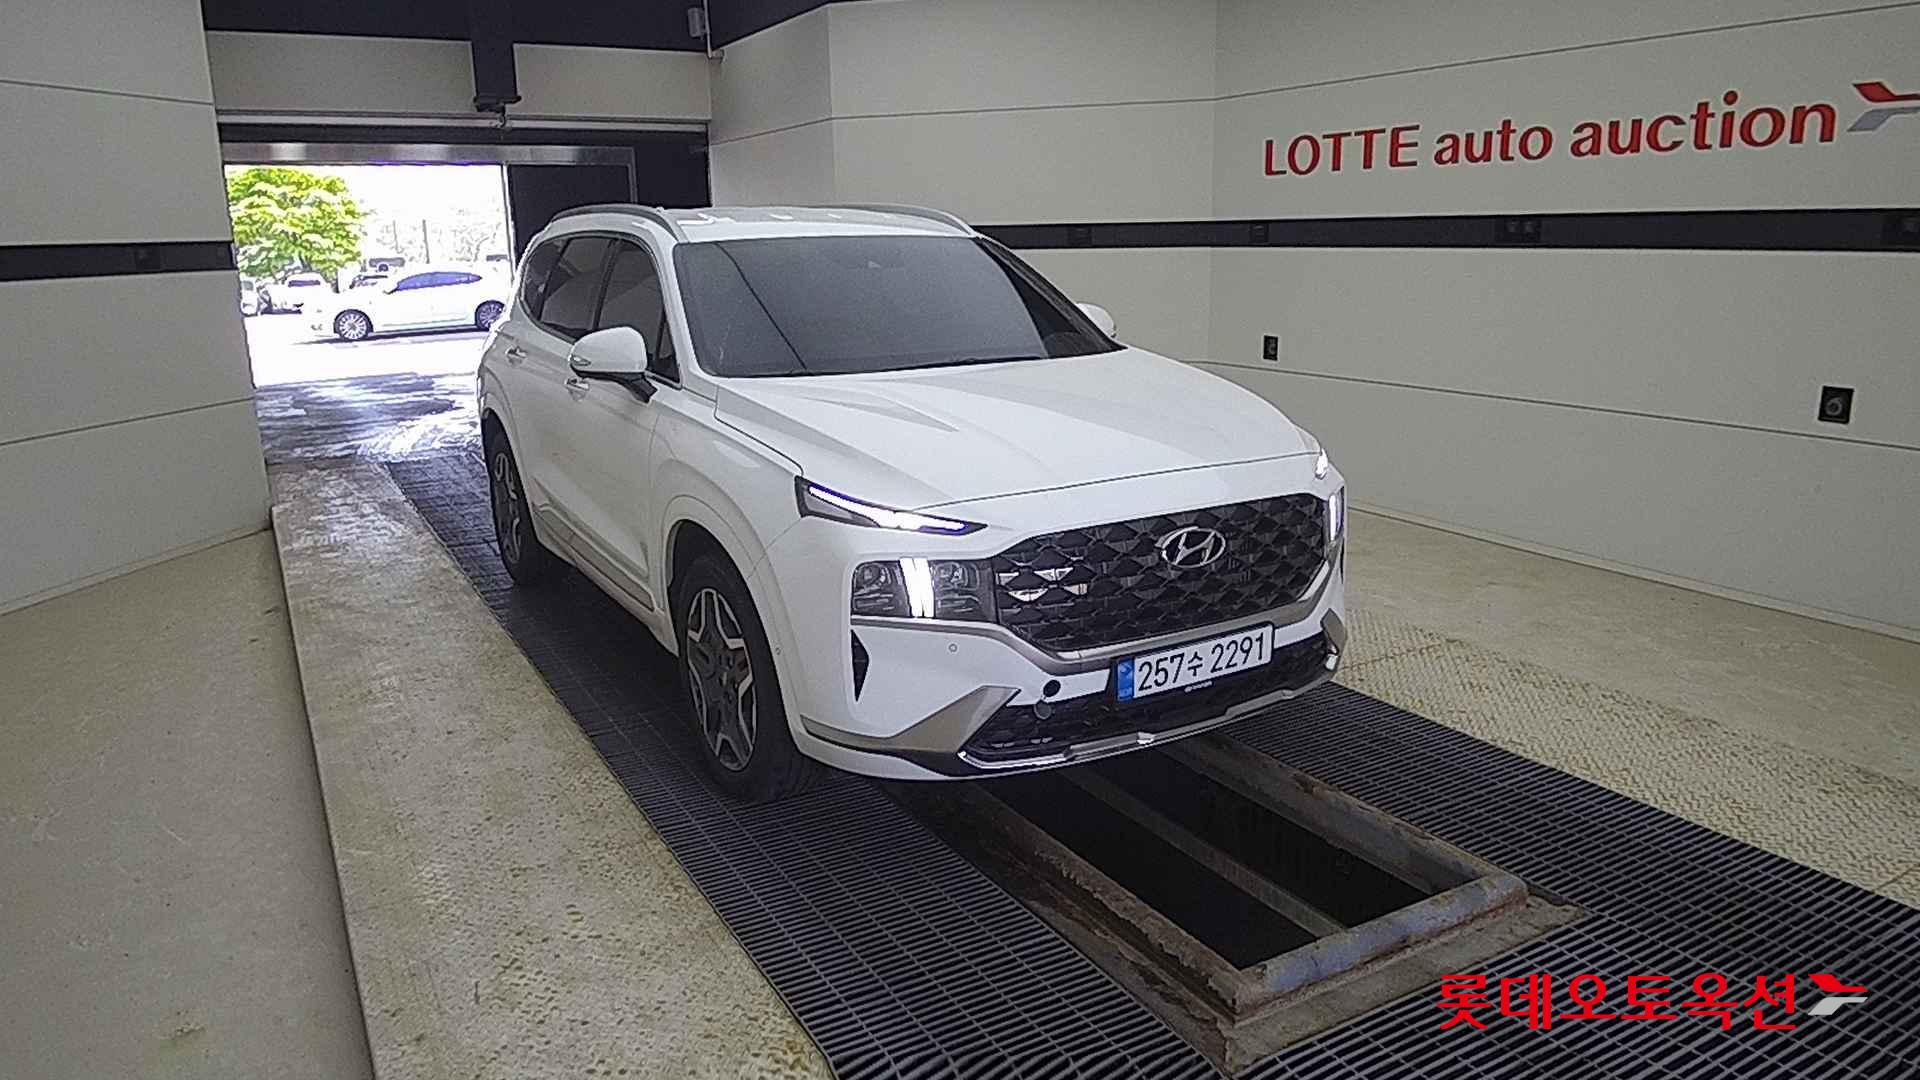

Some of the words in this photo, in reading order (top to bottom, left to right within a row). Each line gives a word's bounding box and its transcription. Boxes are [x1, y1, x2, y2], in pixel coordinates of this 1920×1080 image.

[1264, 125, 1420, 176] LOTTE
[1433, 119, 1553, 165] auto
[1571, 90, 1837, 158] auction
[1138, 651, 1203, 692] 257수
[1210, 632, 1264, 674] 2291
